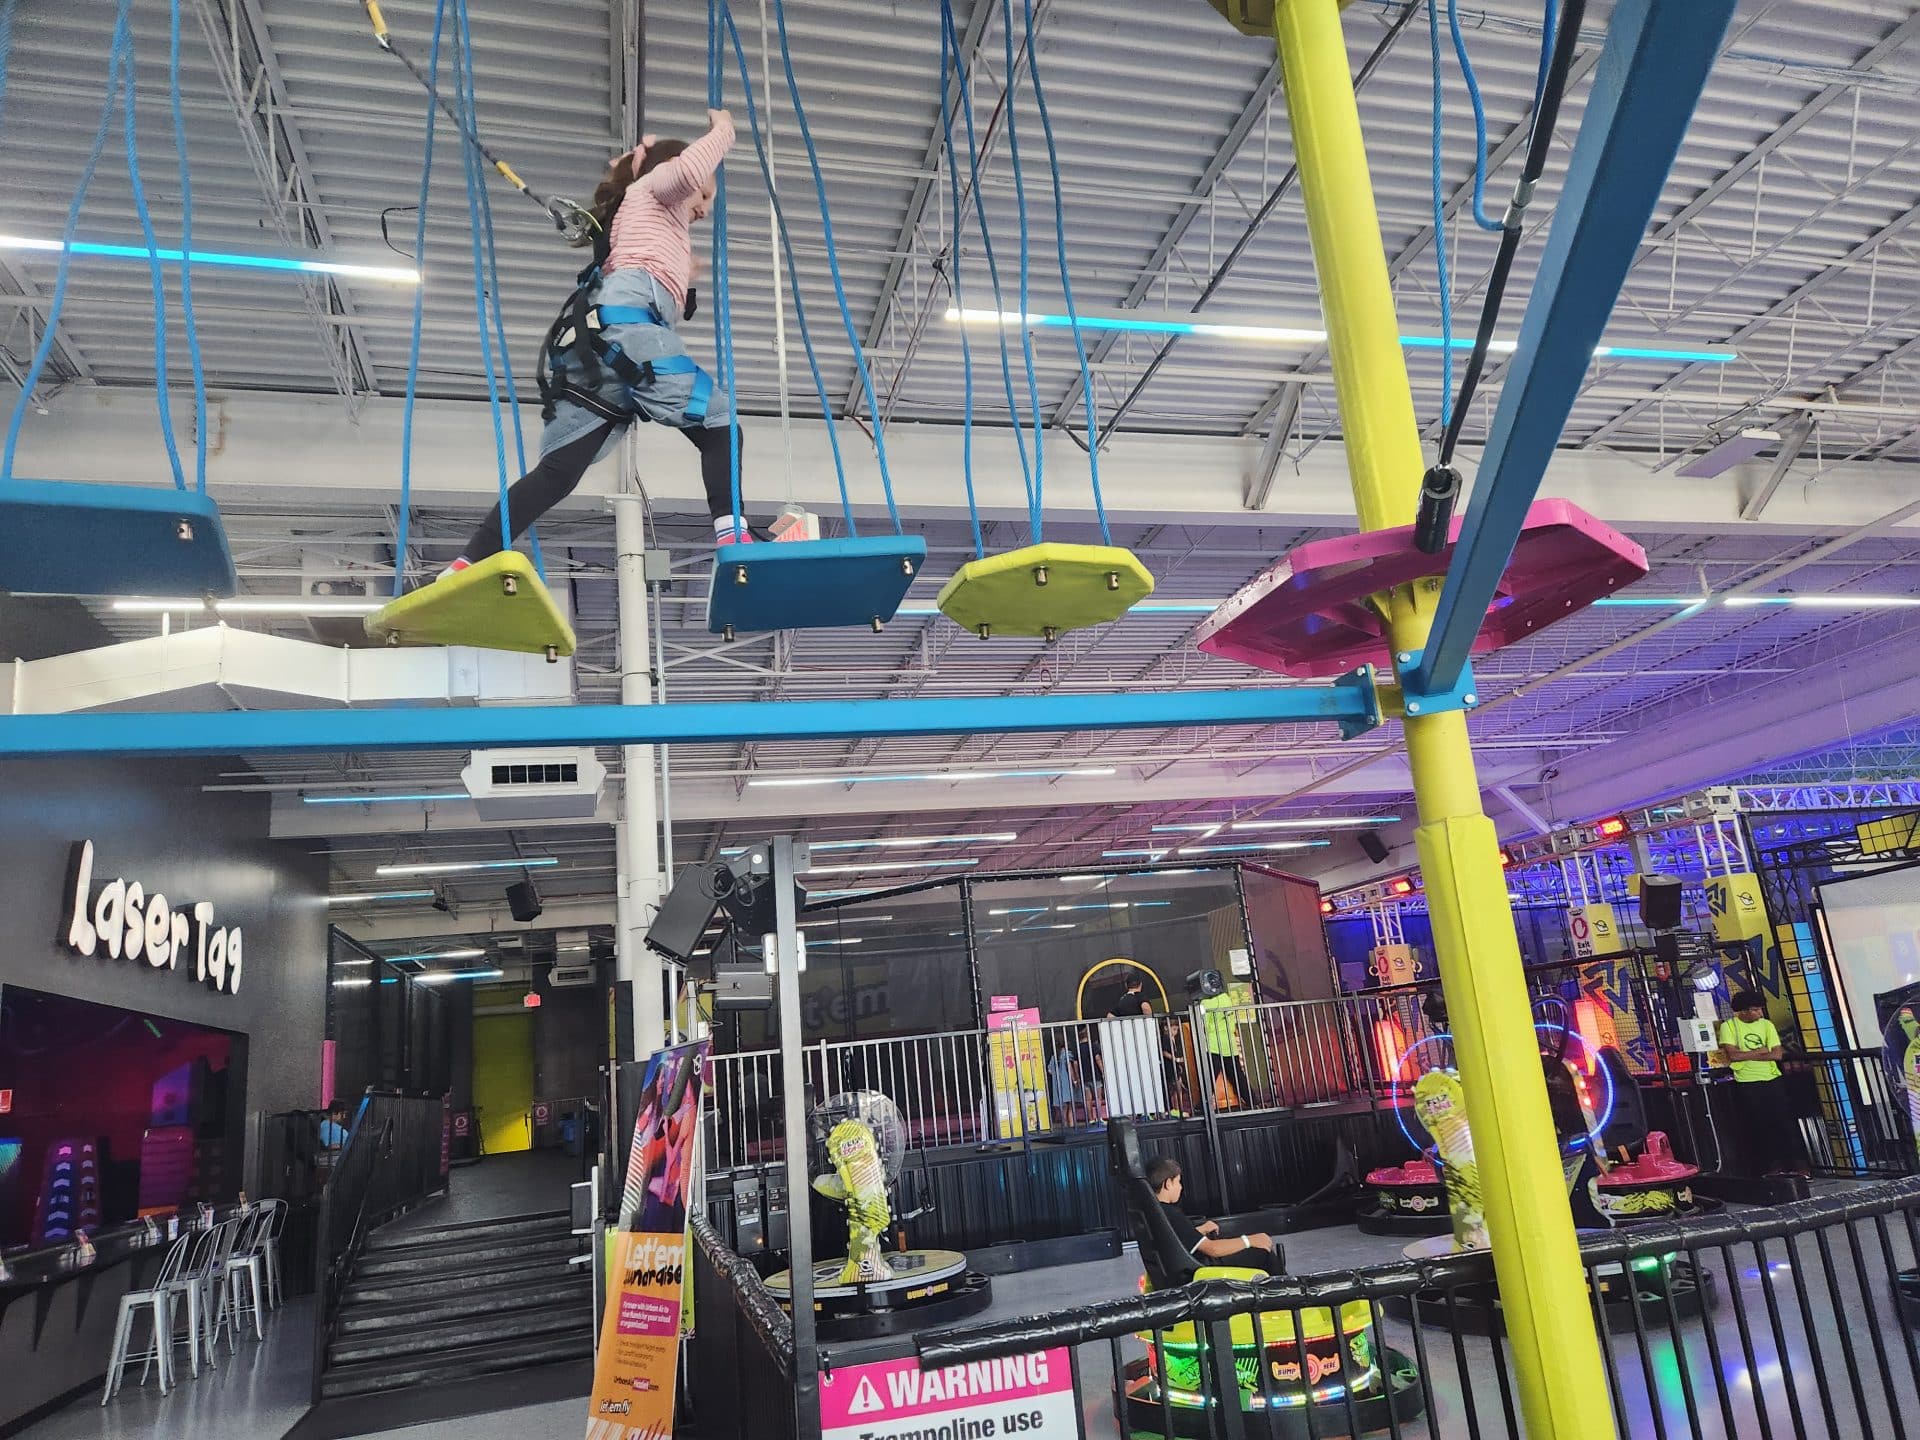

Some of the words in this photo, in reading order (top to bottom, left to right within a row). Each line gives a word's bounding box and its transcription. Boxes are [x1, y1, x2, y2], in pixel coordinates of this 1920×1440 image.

[69, 839, 189, 970] Laser
[194, 901, 242, 994] Tag
[1577, 939, 1591, 949] Exit
[885, 1350, 1049, 1409] WARNING
[860, 1417, 995, 1440] oline
[1002, 1409, 1044, 1435] use
